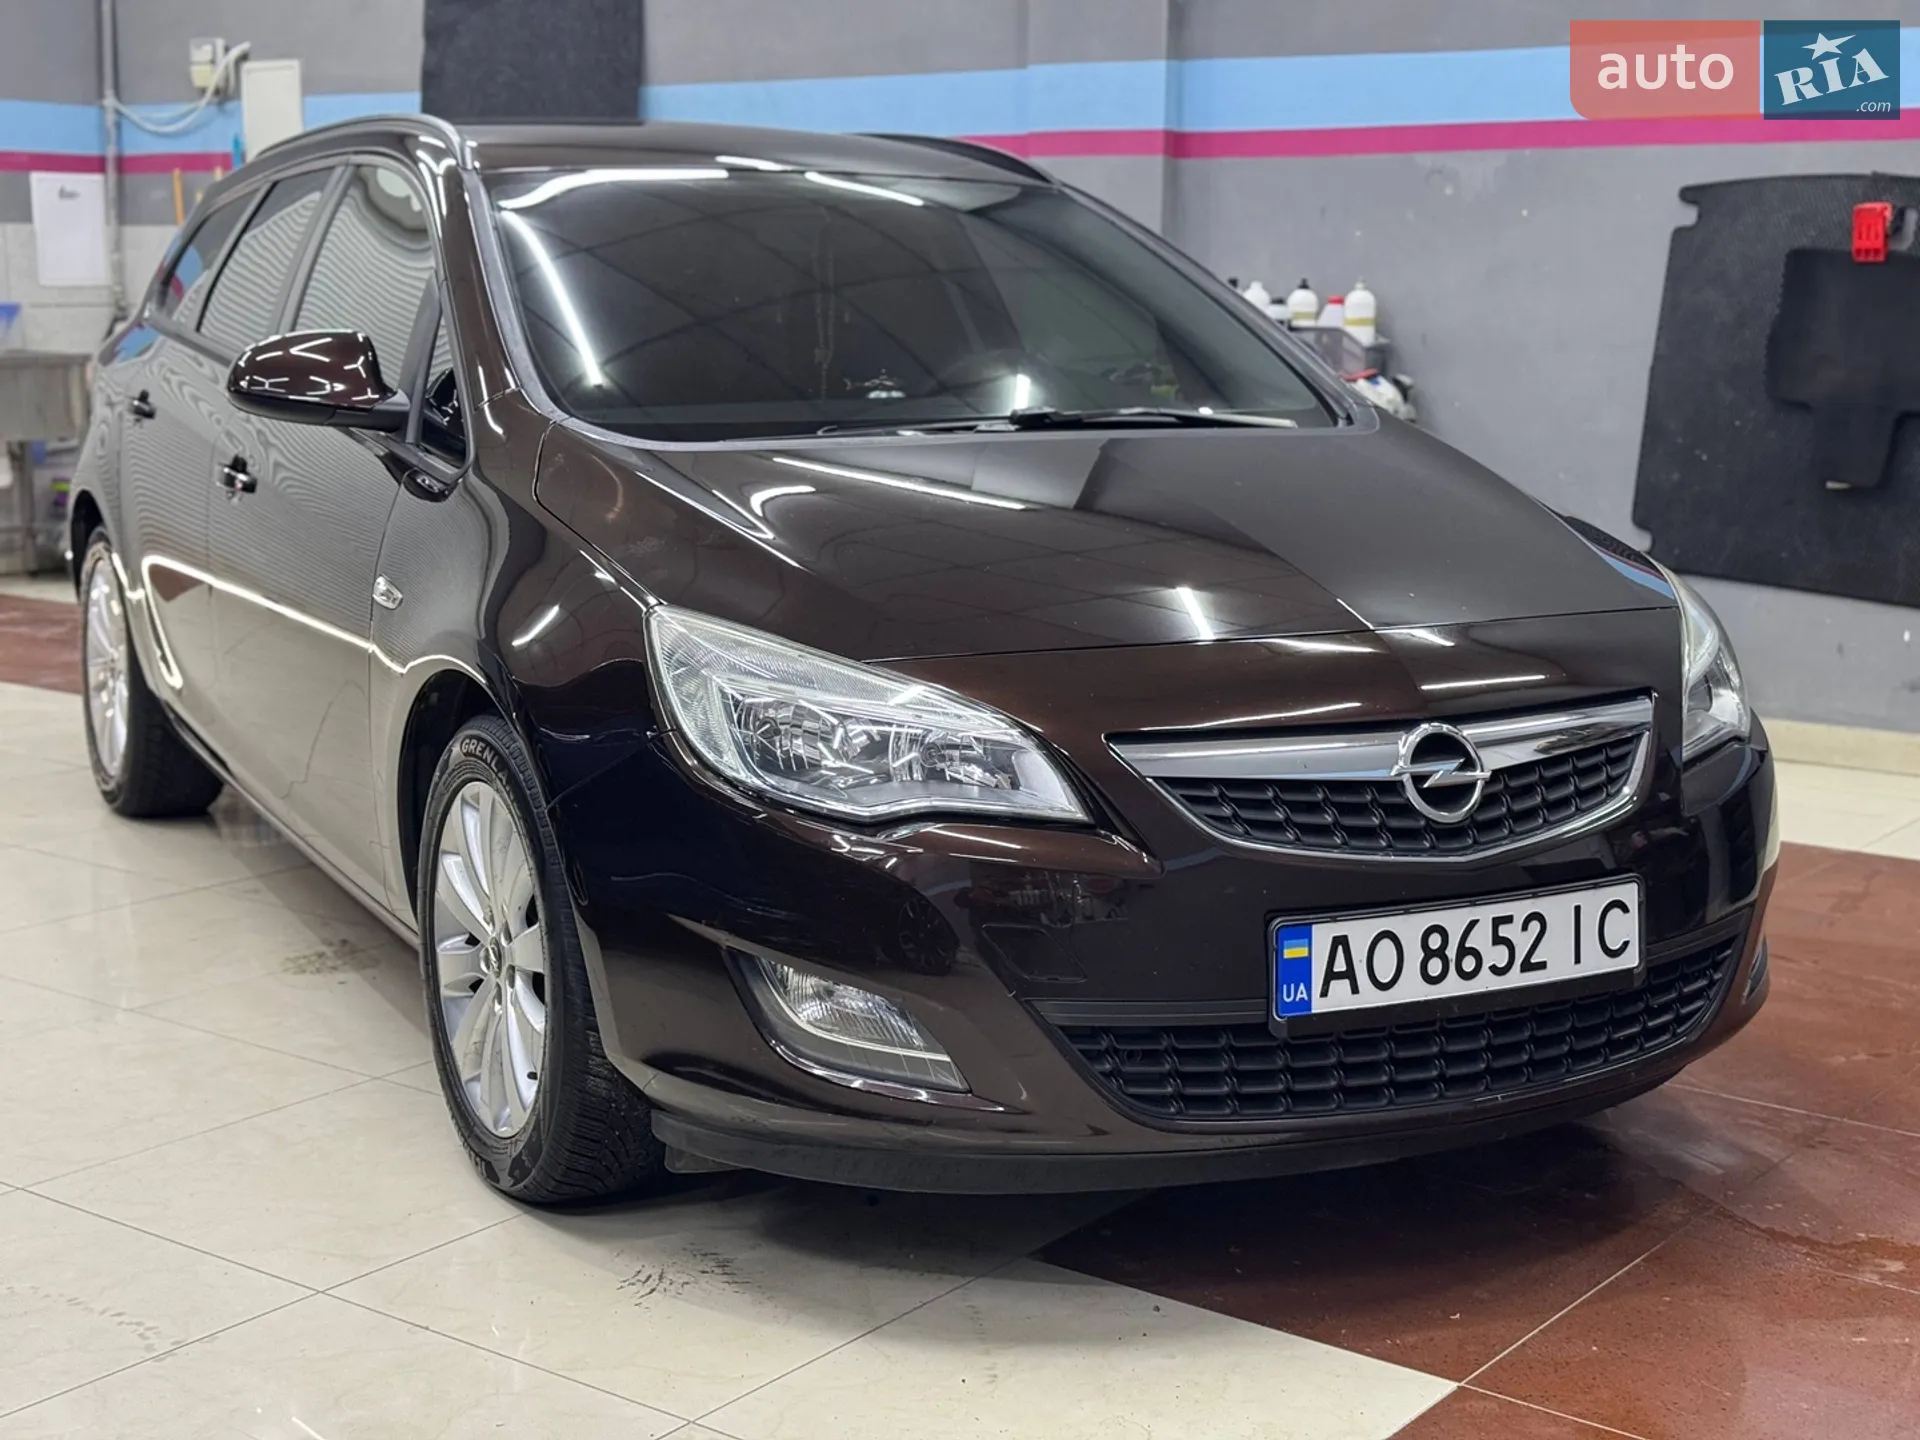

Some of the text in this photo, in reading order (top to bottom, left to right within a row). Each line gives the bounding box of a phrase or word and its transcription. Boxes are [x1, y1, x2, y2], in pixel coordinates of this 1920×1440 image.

[1319, 898, 1631, 998] AO 8652 IC
[1283, 982, 1308, 1003] UA
